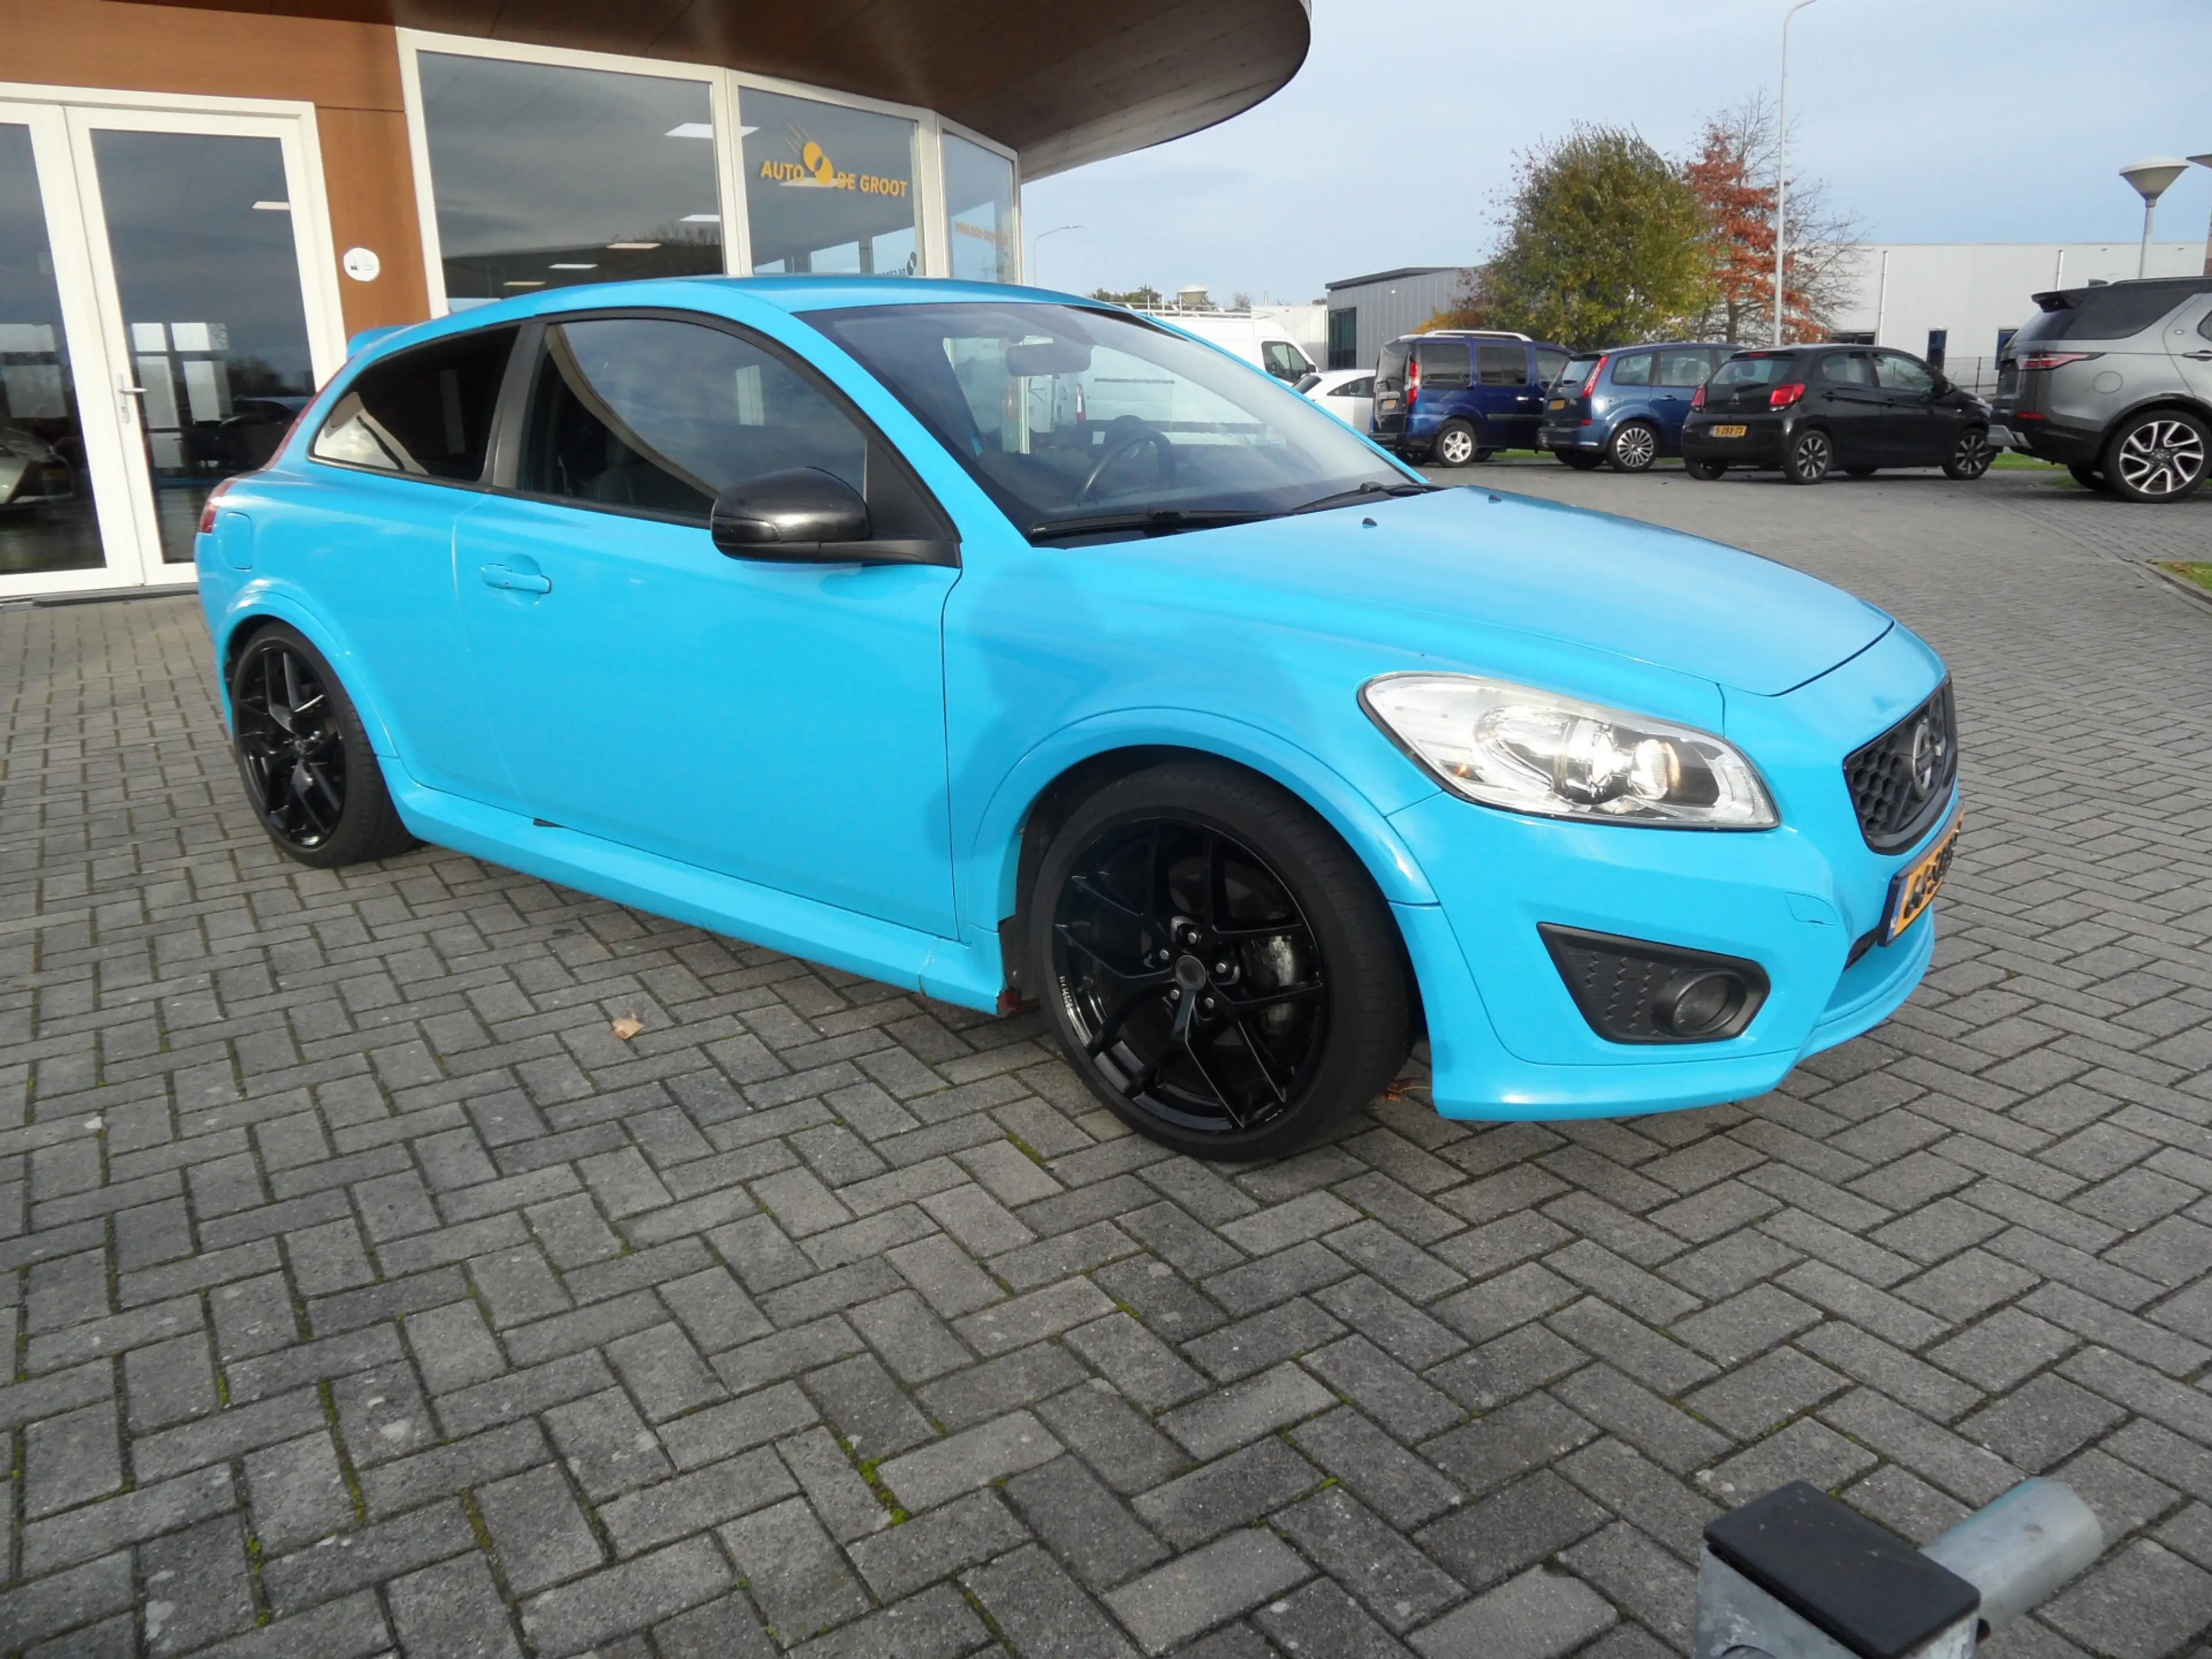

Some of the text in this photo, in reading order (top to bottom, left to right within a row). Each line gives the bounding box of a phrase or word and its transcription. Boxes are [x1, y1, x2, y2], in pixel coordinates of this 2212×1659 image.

[760, 161, 908, 197] AUTO DE GROOT
